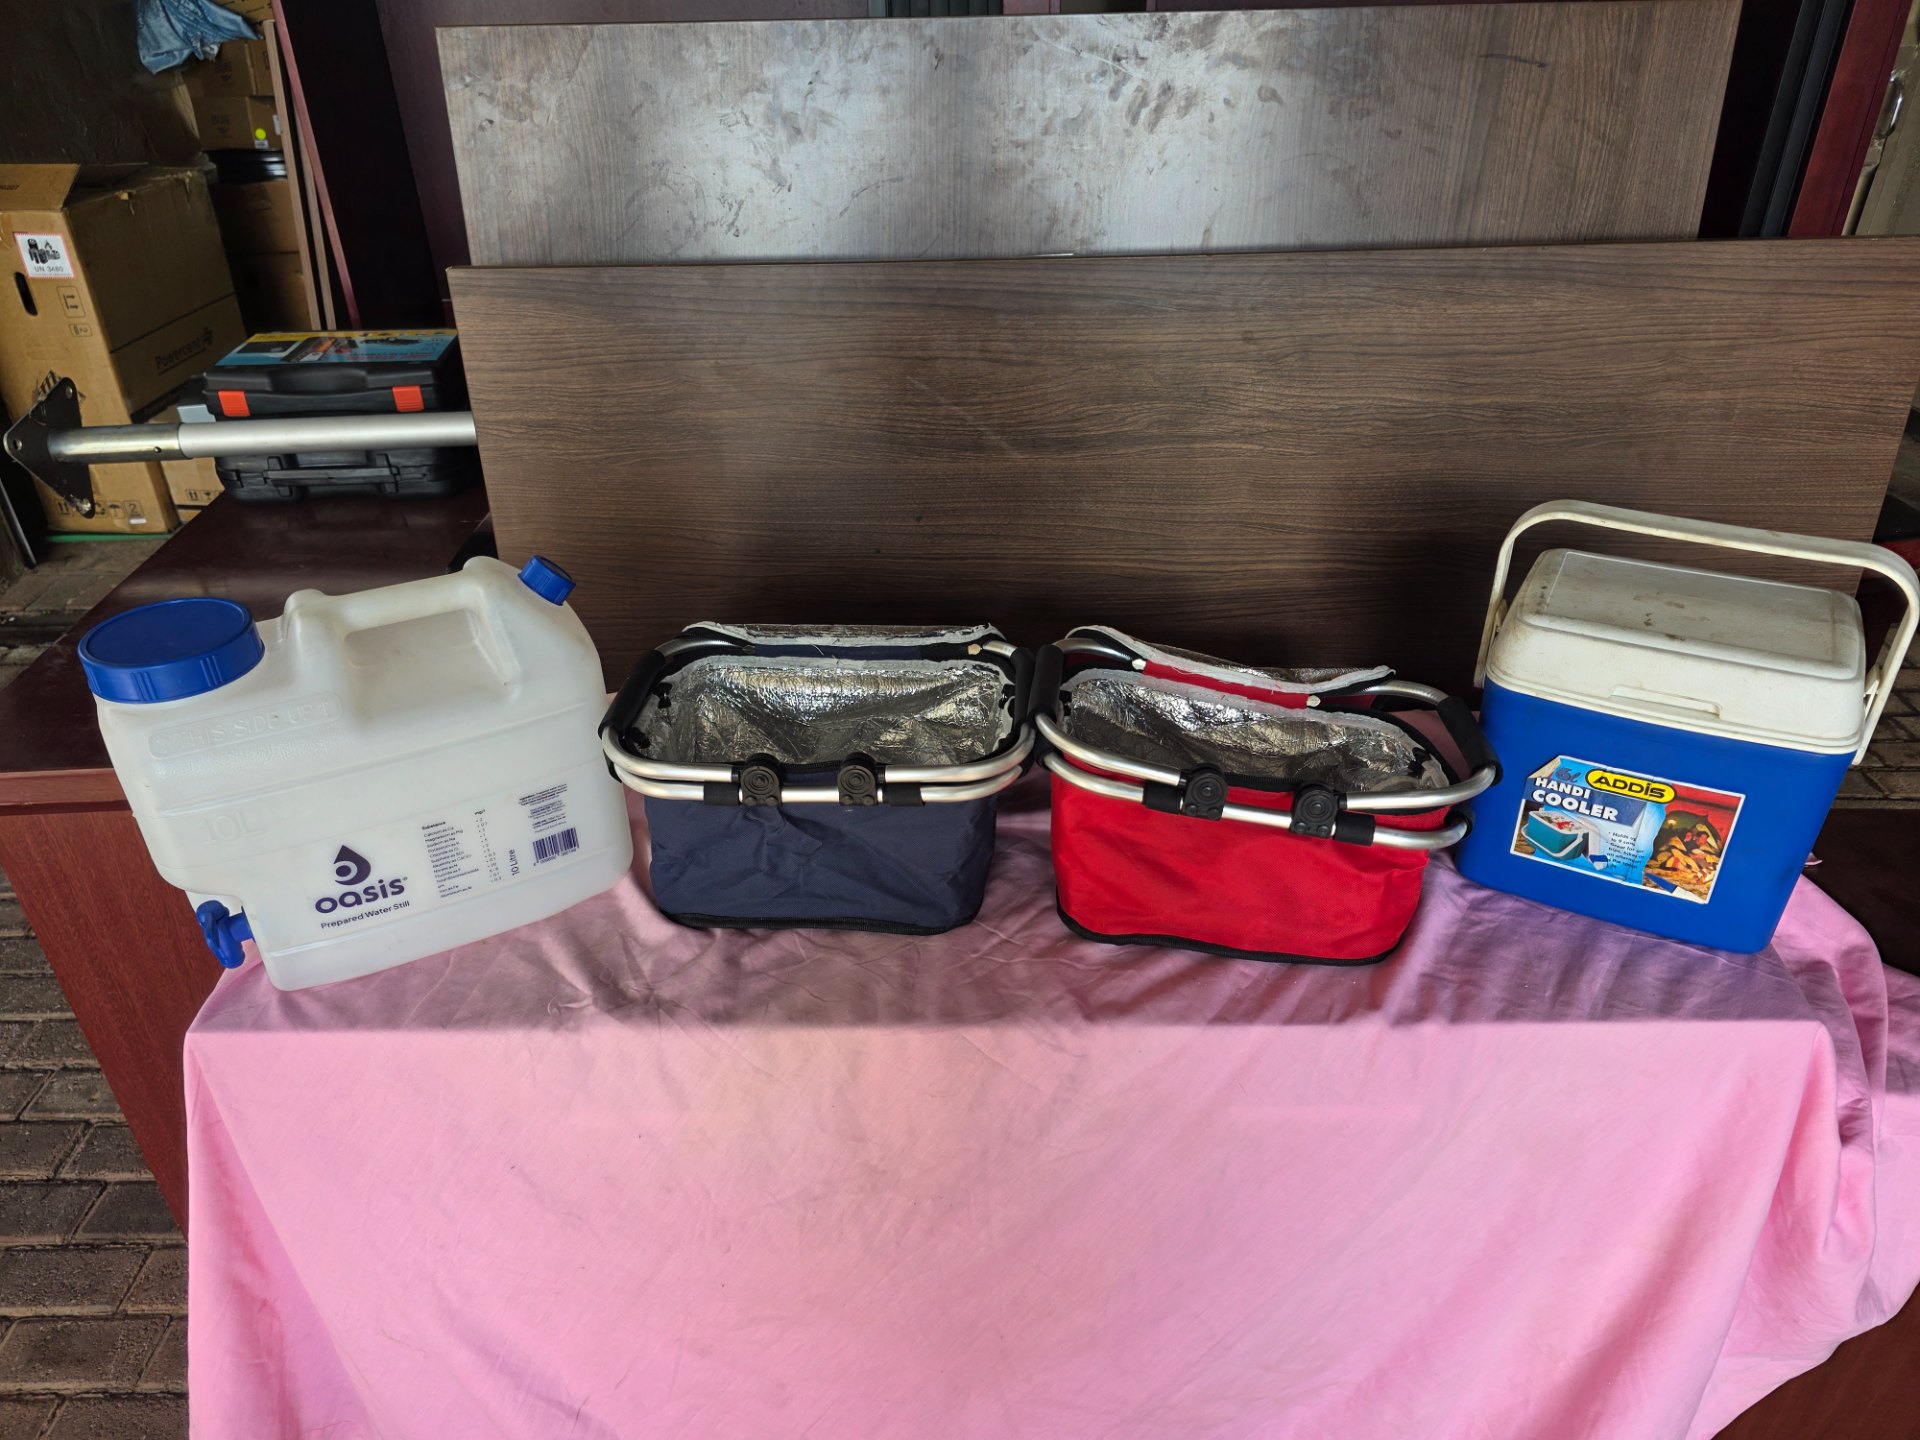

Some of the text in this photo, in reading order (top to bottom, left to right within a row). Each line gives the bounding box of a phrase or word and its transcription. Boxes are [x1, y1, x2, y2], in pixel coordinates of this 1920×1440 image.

[233, 714, 280, 738] SIDE
[1535, 778, 1591, 799] HANDI
[1532, 790, 1619, 822] COOLER
[508, 849, 518, 866] Litre
[315, 878, 405, 913] oasis
[320, 900, 410, 928] Prepared Water Still
